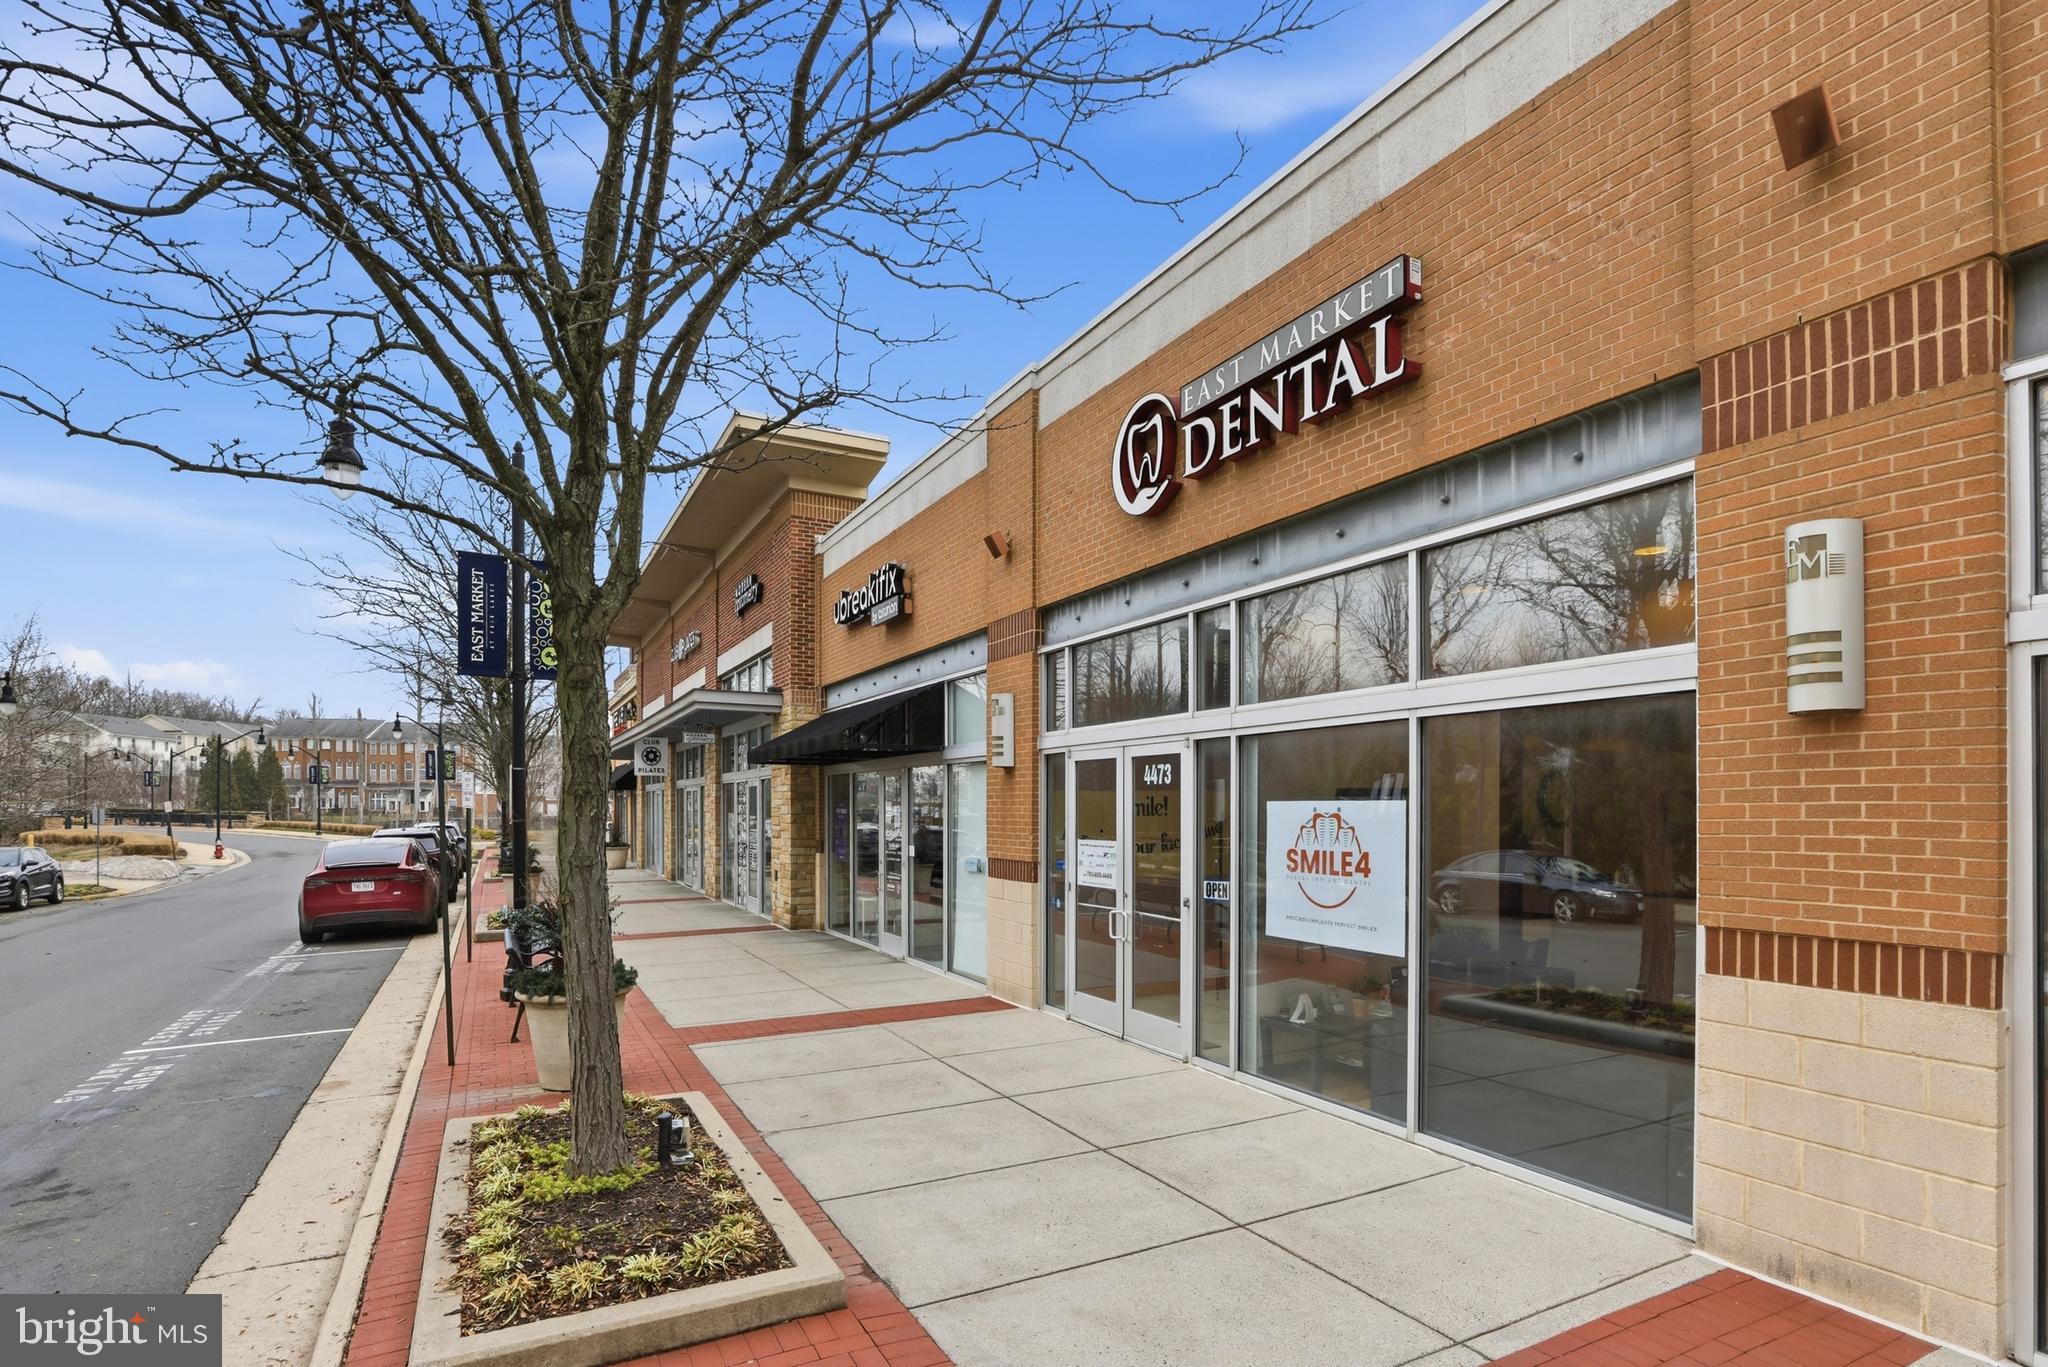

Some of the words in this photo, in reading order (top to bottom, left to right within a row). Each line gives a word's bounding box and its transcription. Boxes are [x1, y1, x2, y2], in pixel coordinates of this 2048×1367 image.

[1182, 355, 1244, 413] EAST
[1259, 263, 1401, 371] MARKET
[1182, 314, 1405, 478] DENTAL
[471, 568, 484, 623] MARKET
[833, 563, 897, 624] ubreakifix
[471, 626, 484, 662] EAST
[1143, 763, 1172, 785] 4473
[1286, 848, 1371, 878] SMILE4
[1205, 882, 1228, 899] OPEN
